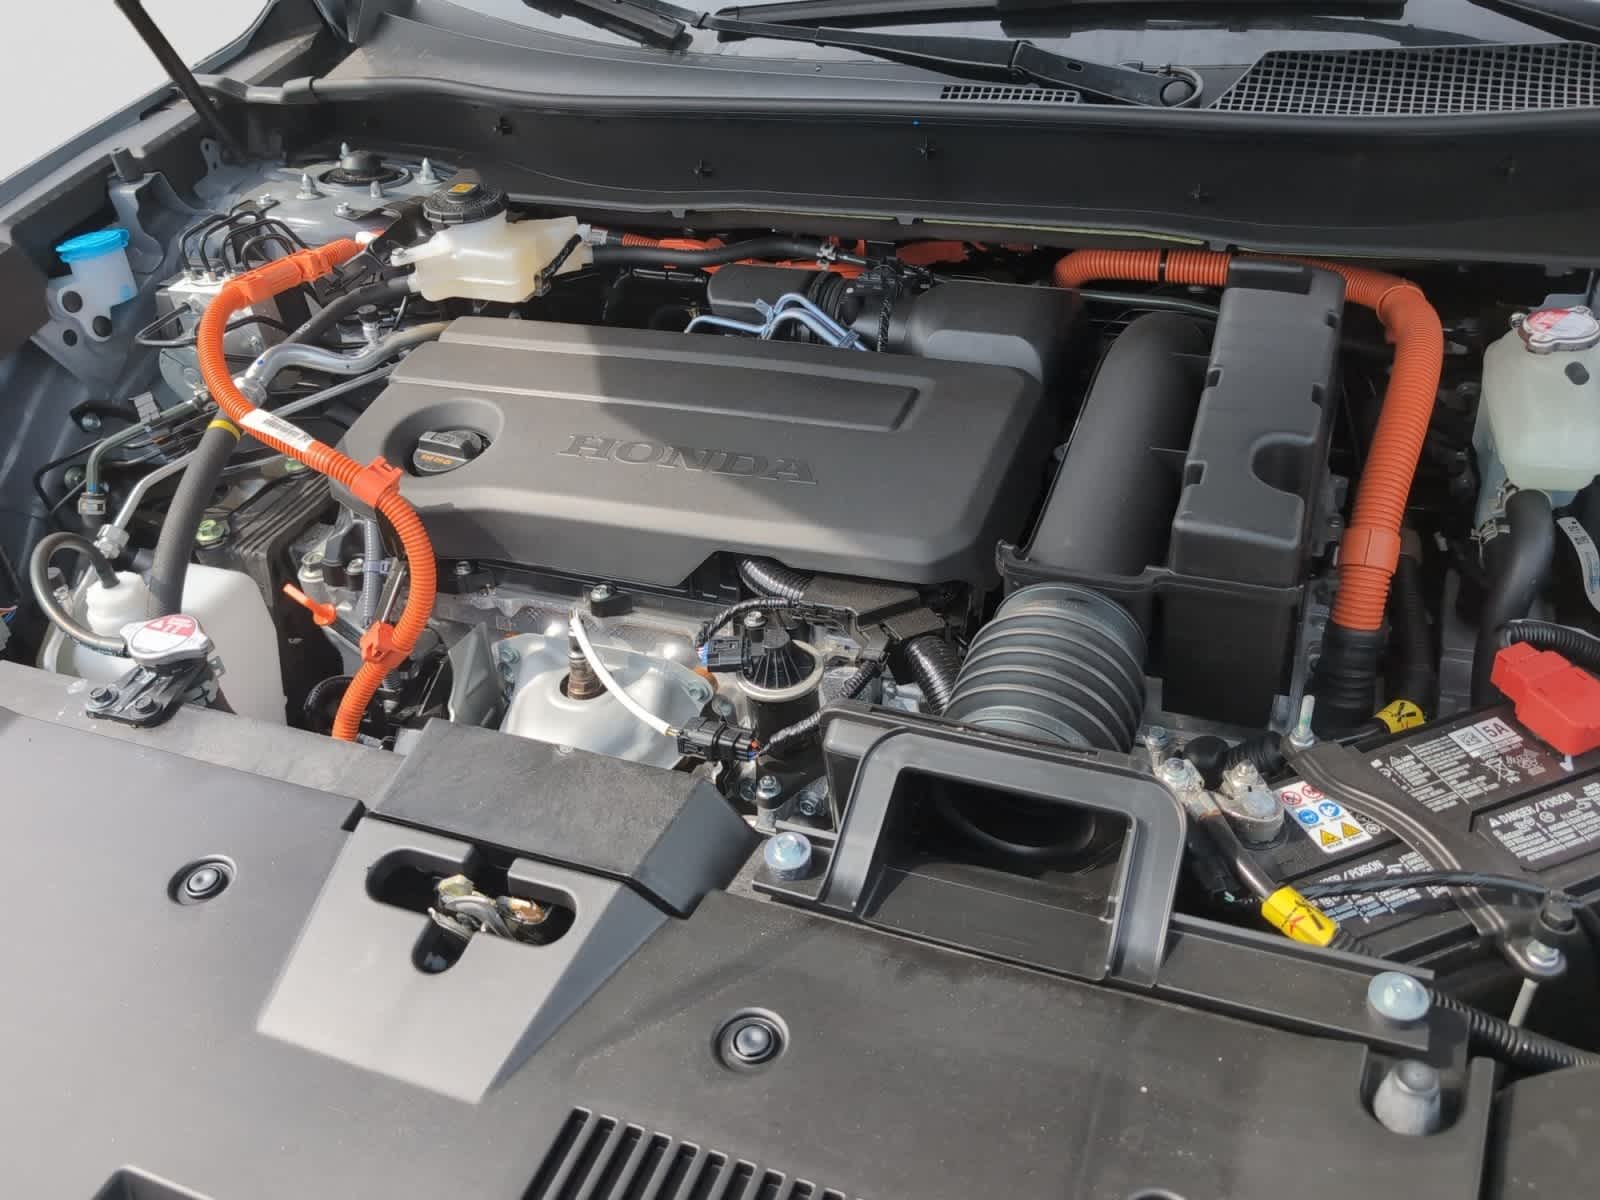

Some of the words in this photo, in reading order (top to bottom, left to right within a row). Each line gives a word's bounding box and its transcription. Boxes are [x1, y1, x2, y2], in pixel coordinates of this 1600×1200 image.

[557, 434, 817, 485] HONDA
[1482, 722, 1509, 738] 5A
[1349, 860, 1384, 878] POISON
